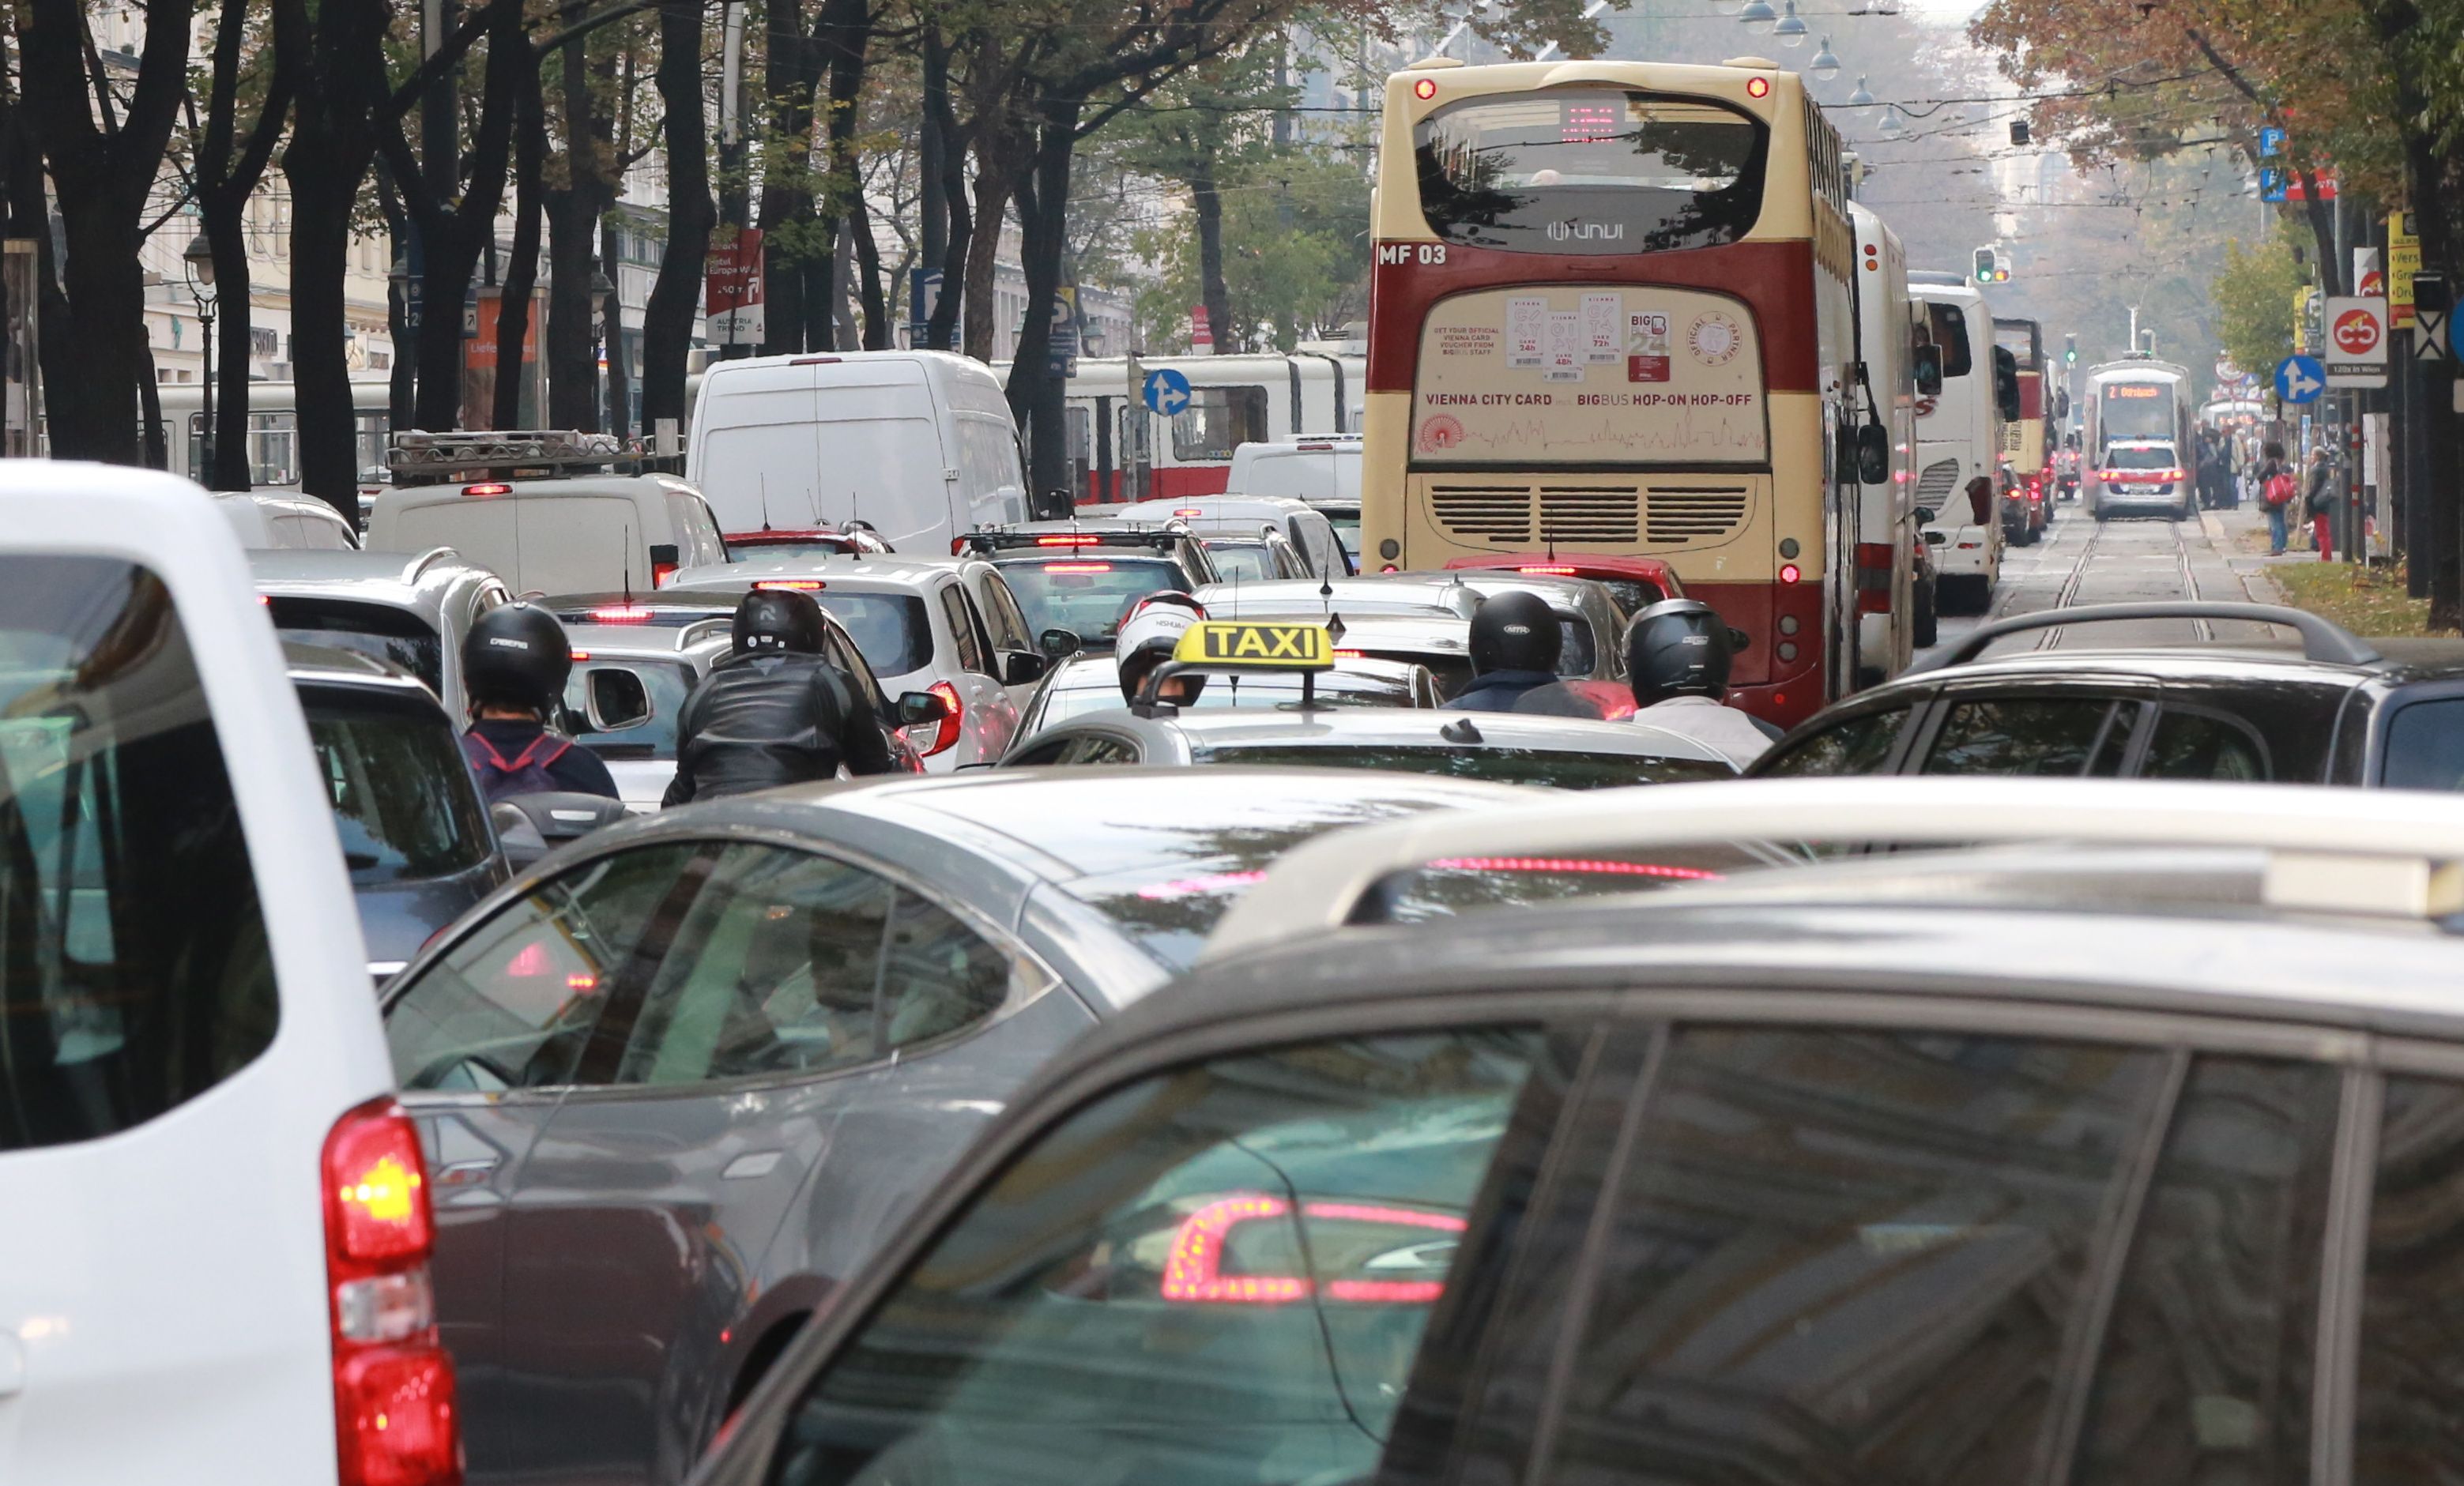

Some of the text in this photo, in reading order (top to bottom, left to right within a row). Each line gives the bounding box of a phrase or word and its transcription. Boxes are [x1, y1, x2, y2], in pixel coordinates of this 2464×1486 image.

[1379, 245, 1446, 265] MF 03
[1631, 315, 1650, 325] BIG
[1721, 322, 1740, 363] PARTNER
[1426, 394, 1479, 405] VIENNA
[1482, 394, 1512, 405] CITY
[1515, 394, 1552, 405] CARD
[1577, 394, 1629, 405] BIGBUS
[1633, 394, 1686, 405] HOP-ON
[1691, 394, 1752, 405] HOP-OFF
[1207, 627, 1314, 657] TAXI
